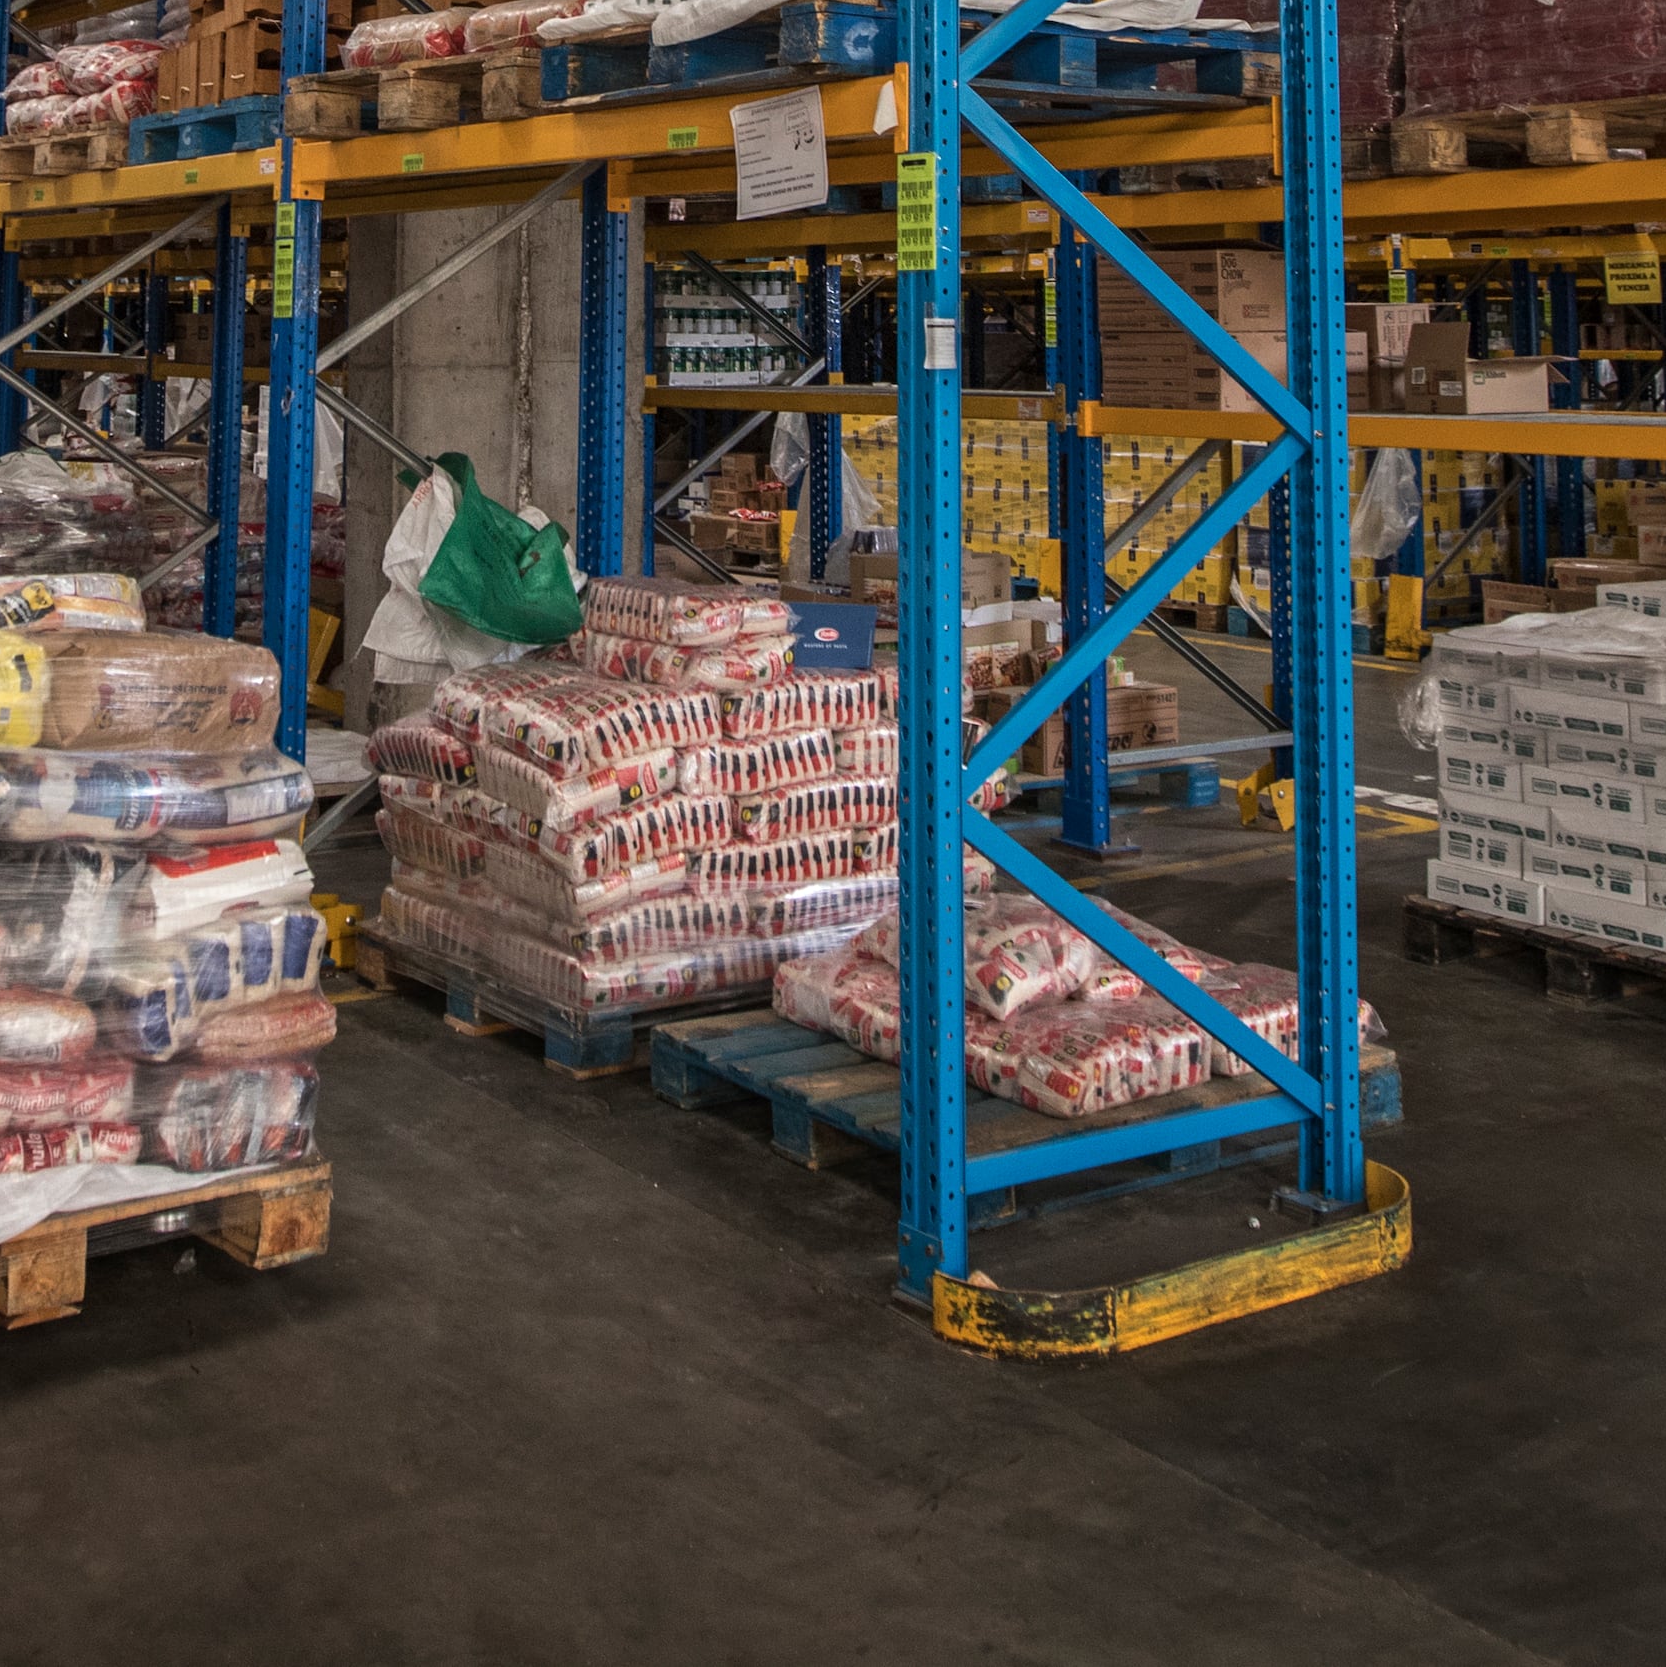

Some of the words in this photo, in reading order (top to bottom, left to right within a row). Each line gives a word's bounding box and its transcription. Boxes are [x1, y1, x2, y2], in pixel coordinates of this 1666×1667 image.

[1221, 256, 1237, 268] DOG
[1221, 268, 1245, 280] CHOW
[1616, 284, 1651, 293] VENCER
